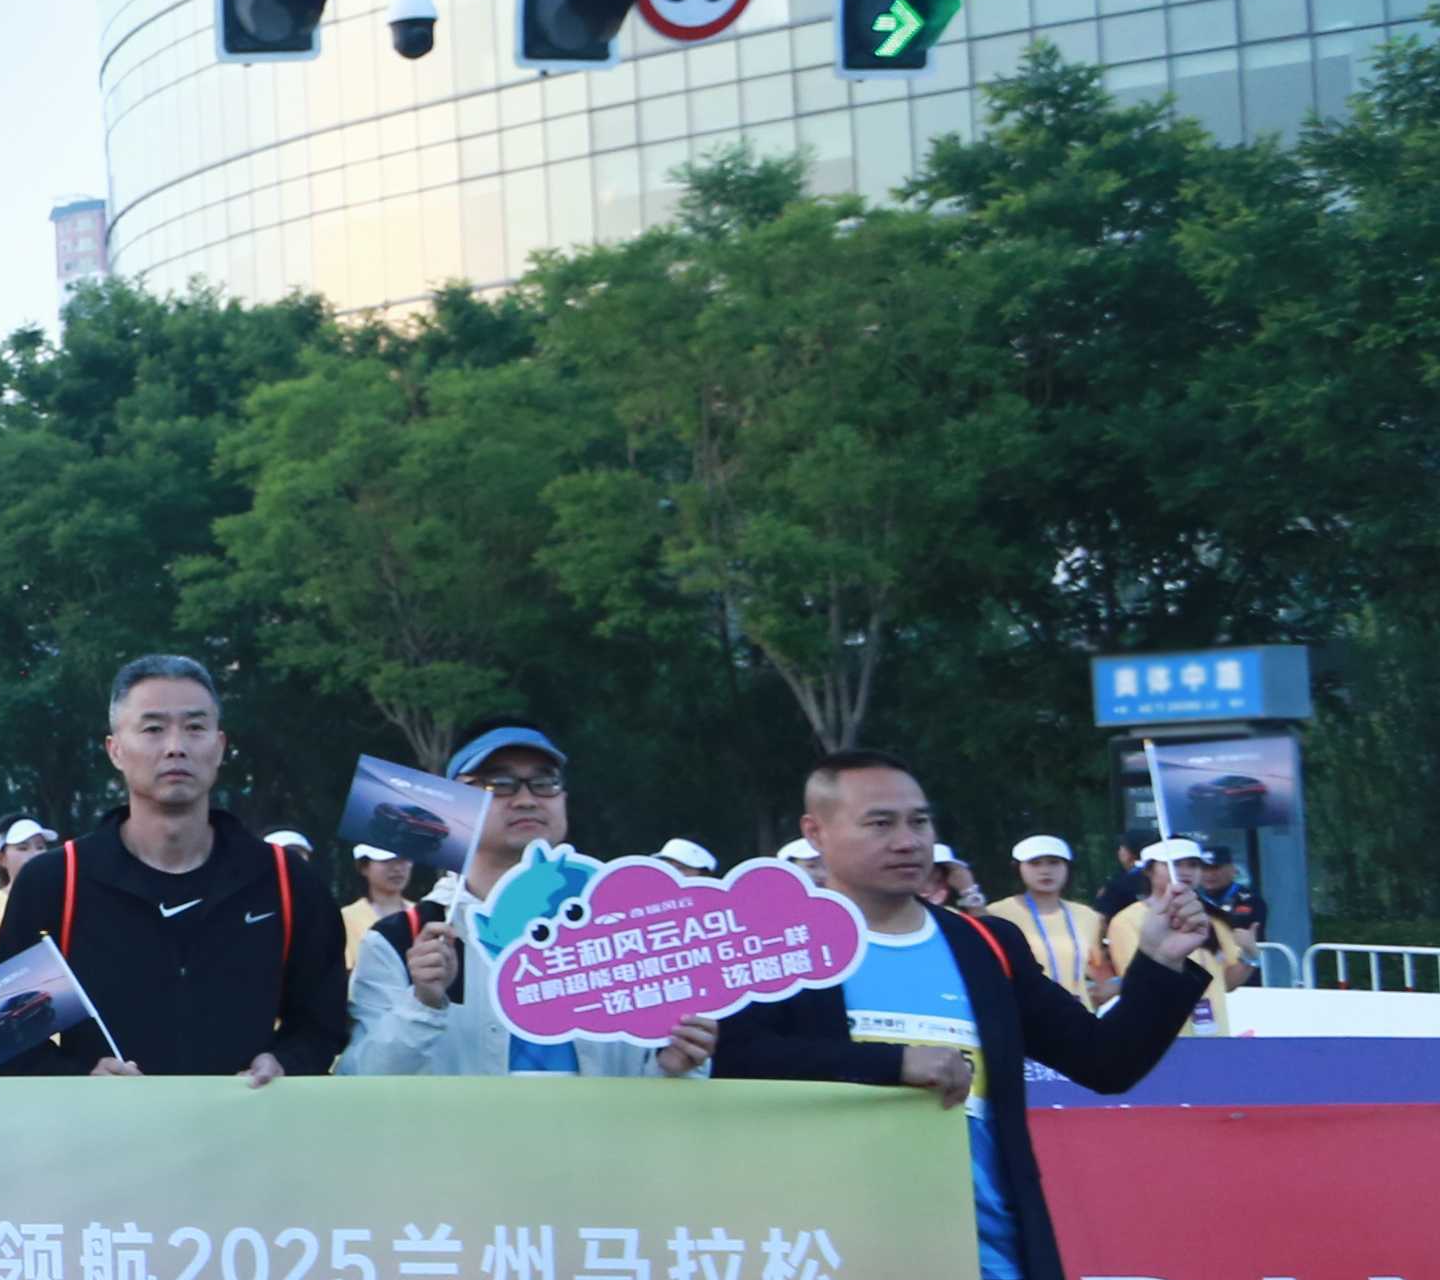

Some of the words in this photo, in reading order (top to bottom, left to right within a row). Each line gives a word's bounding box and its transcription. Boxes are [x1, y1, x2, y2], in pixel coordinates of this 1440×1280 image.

[511, 908, 747, 983] 人生和风云A9L
